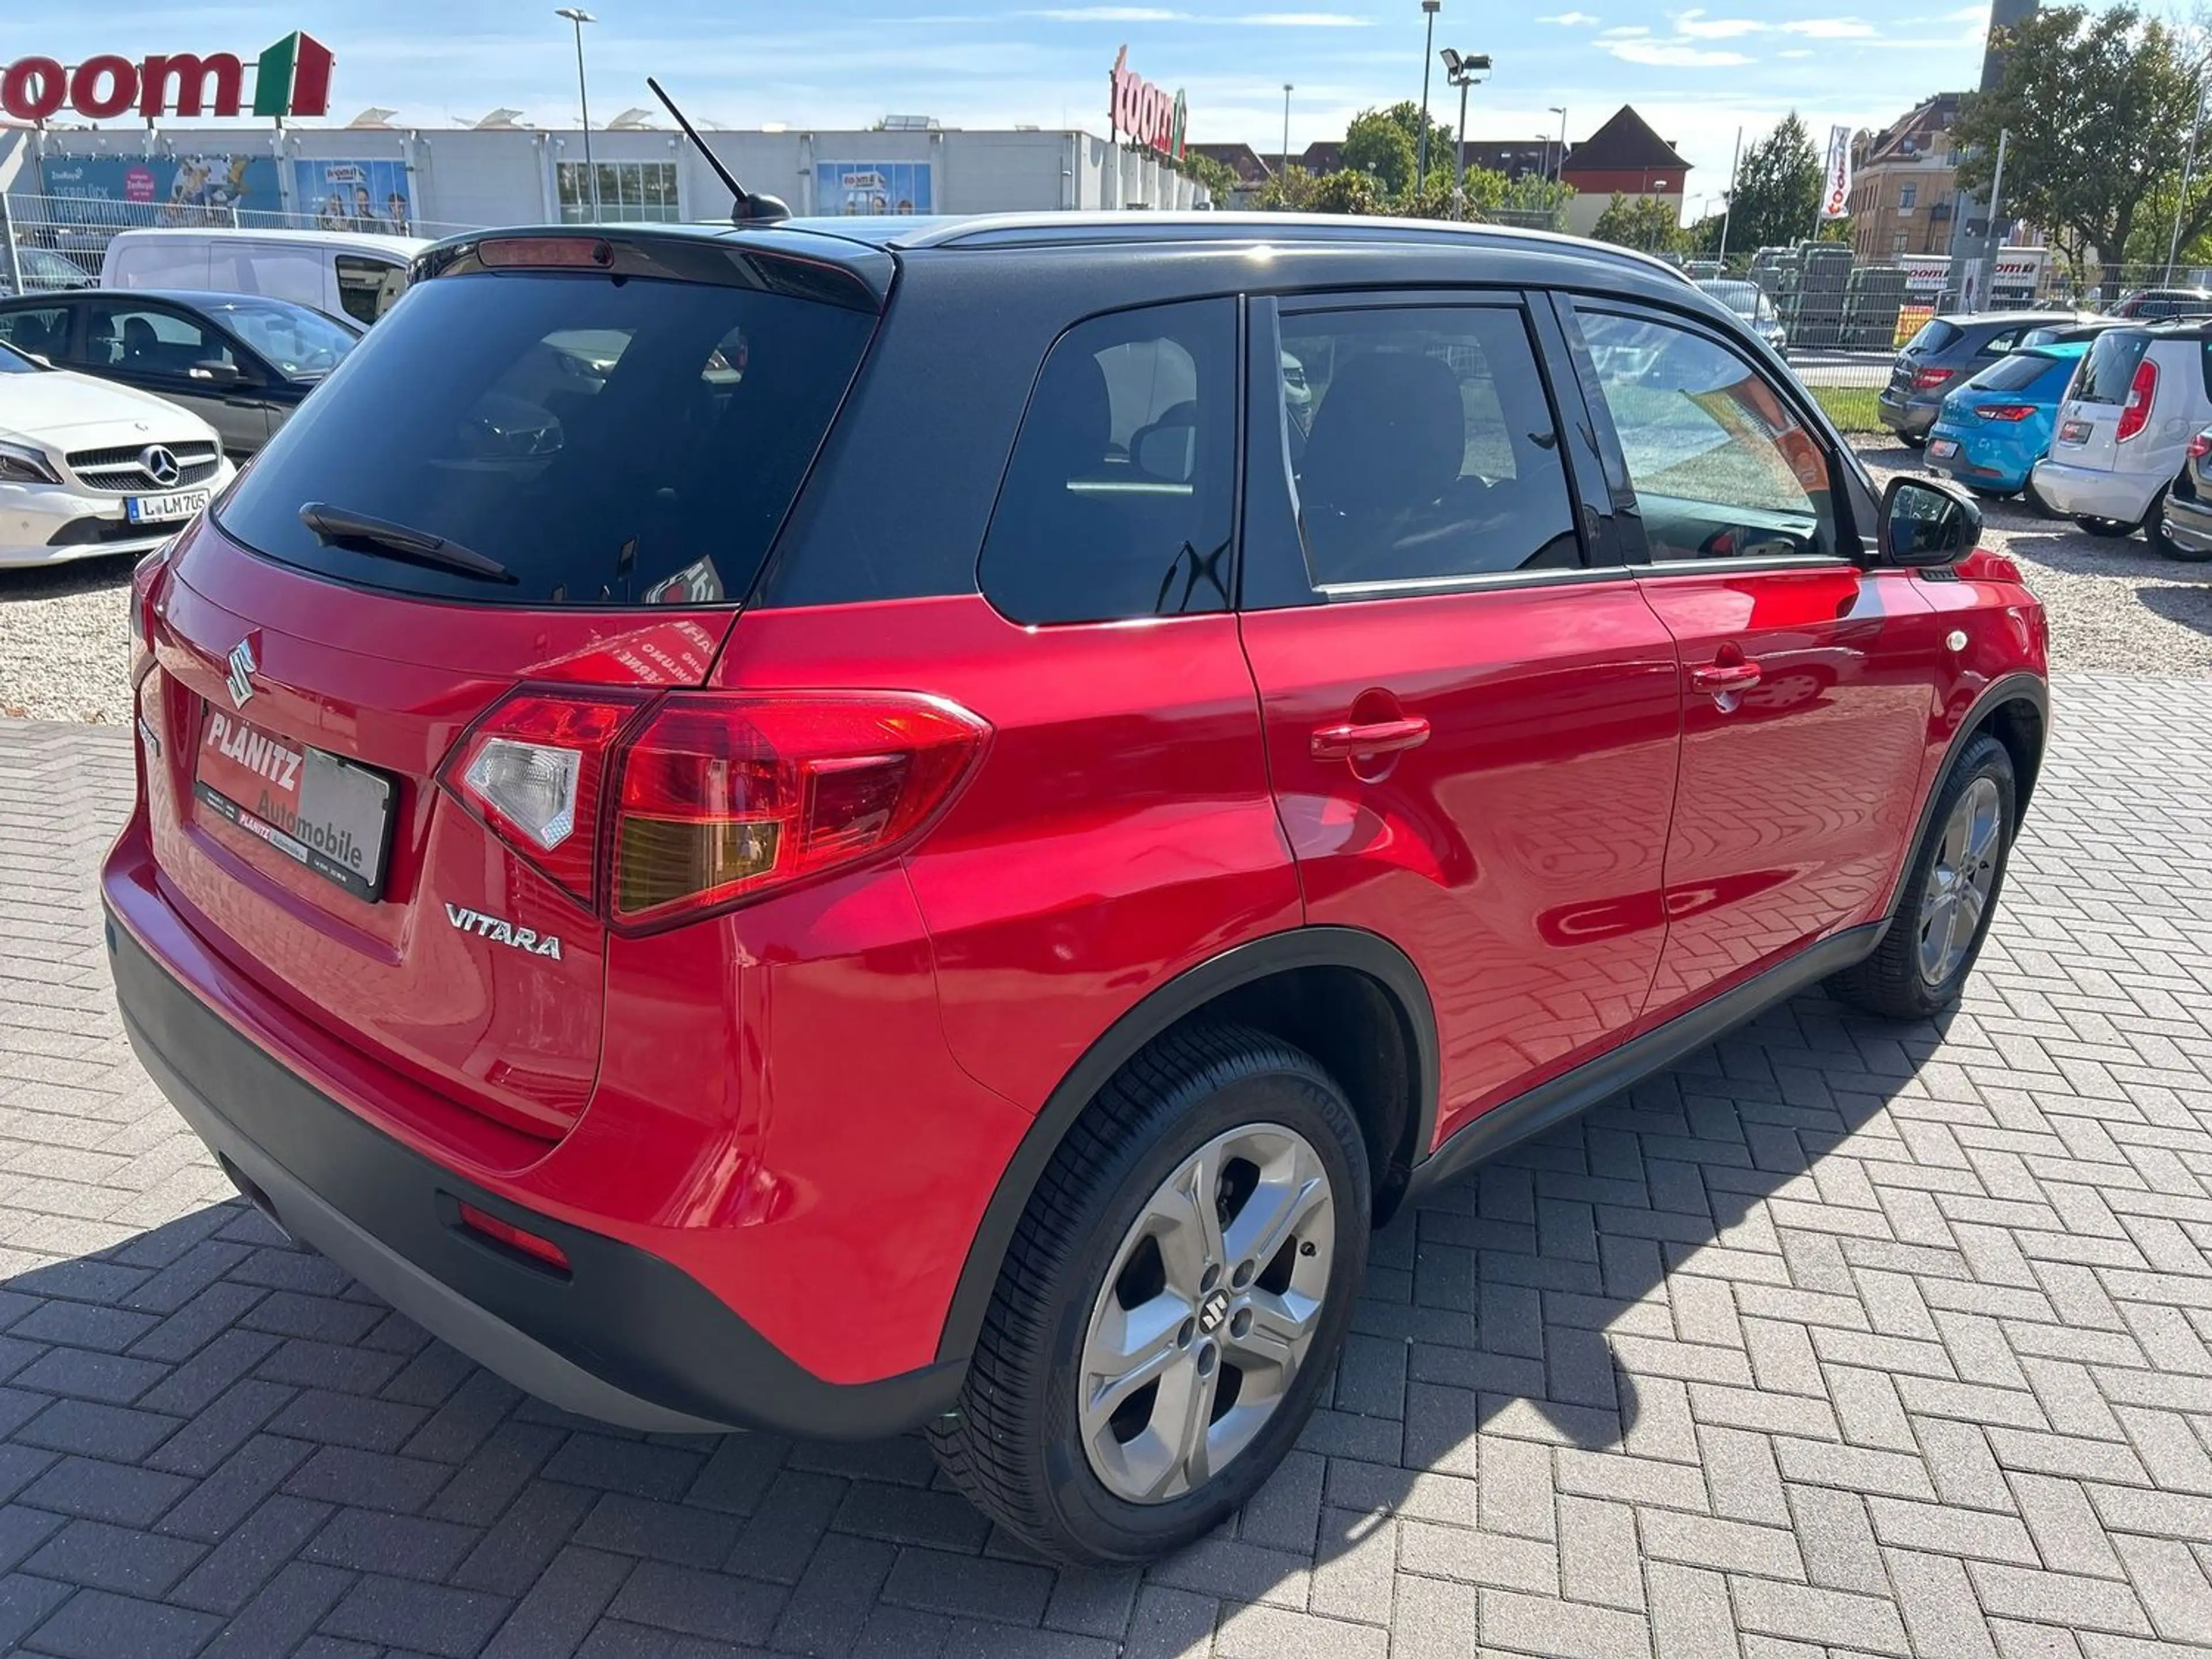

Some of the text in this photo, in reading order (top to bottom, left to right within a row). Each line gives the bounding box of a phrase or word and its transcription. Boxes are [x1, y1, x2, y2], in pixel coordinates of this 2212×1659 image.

[1, 53, 242, 119] oom
[1115, 44, 1173, 155] toom
[1908, 270, 1941, 278] oom
[1995, 263, 2021, 273] om
[207, 713, 302, 791] PLÄNITZ
[259, 789, 362, 869] Automobile
[445, 903, 561, 961] VITARA
